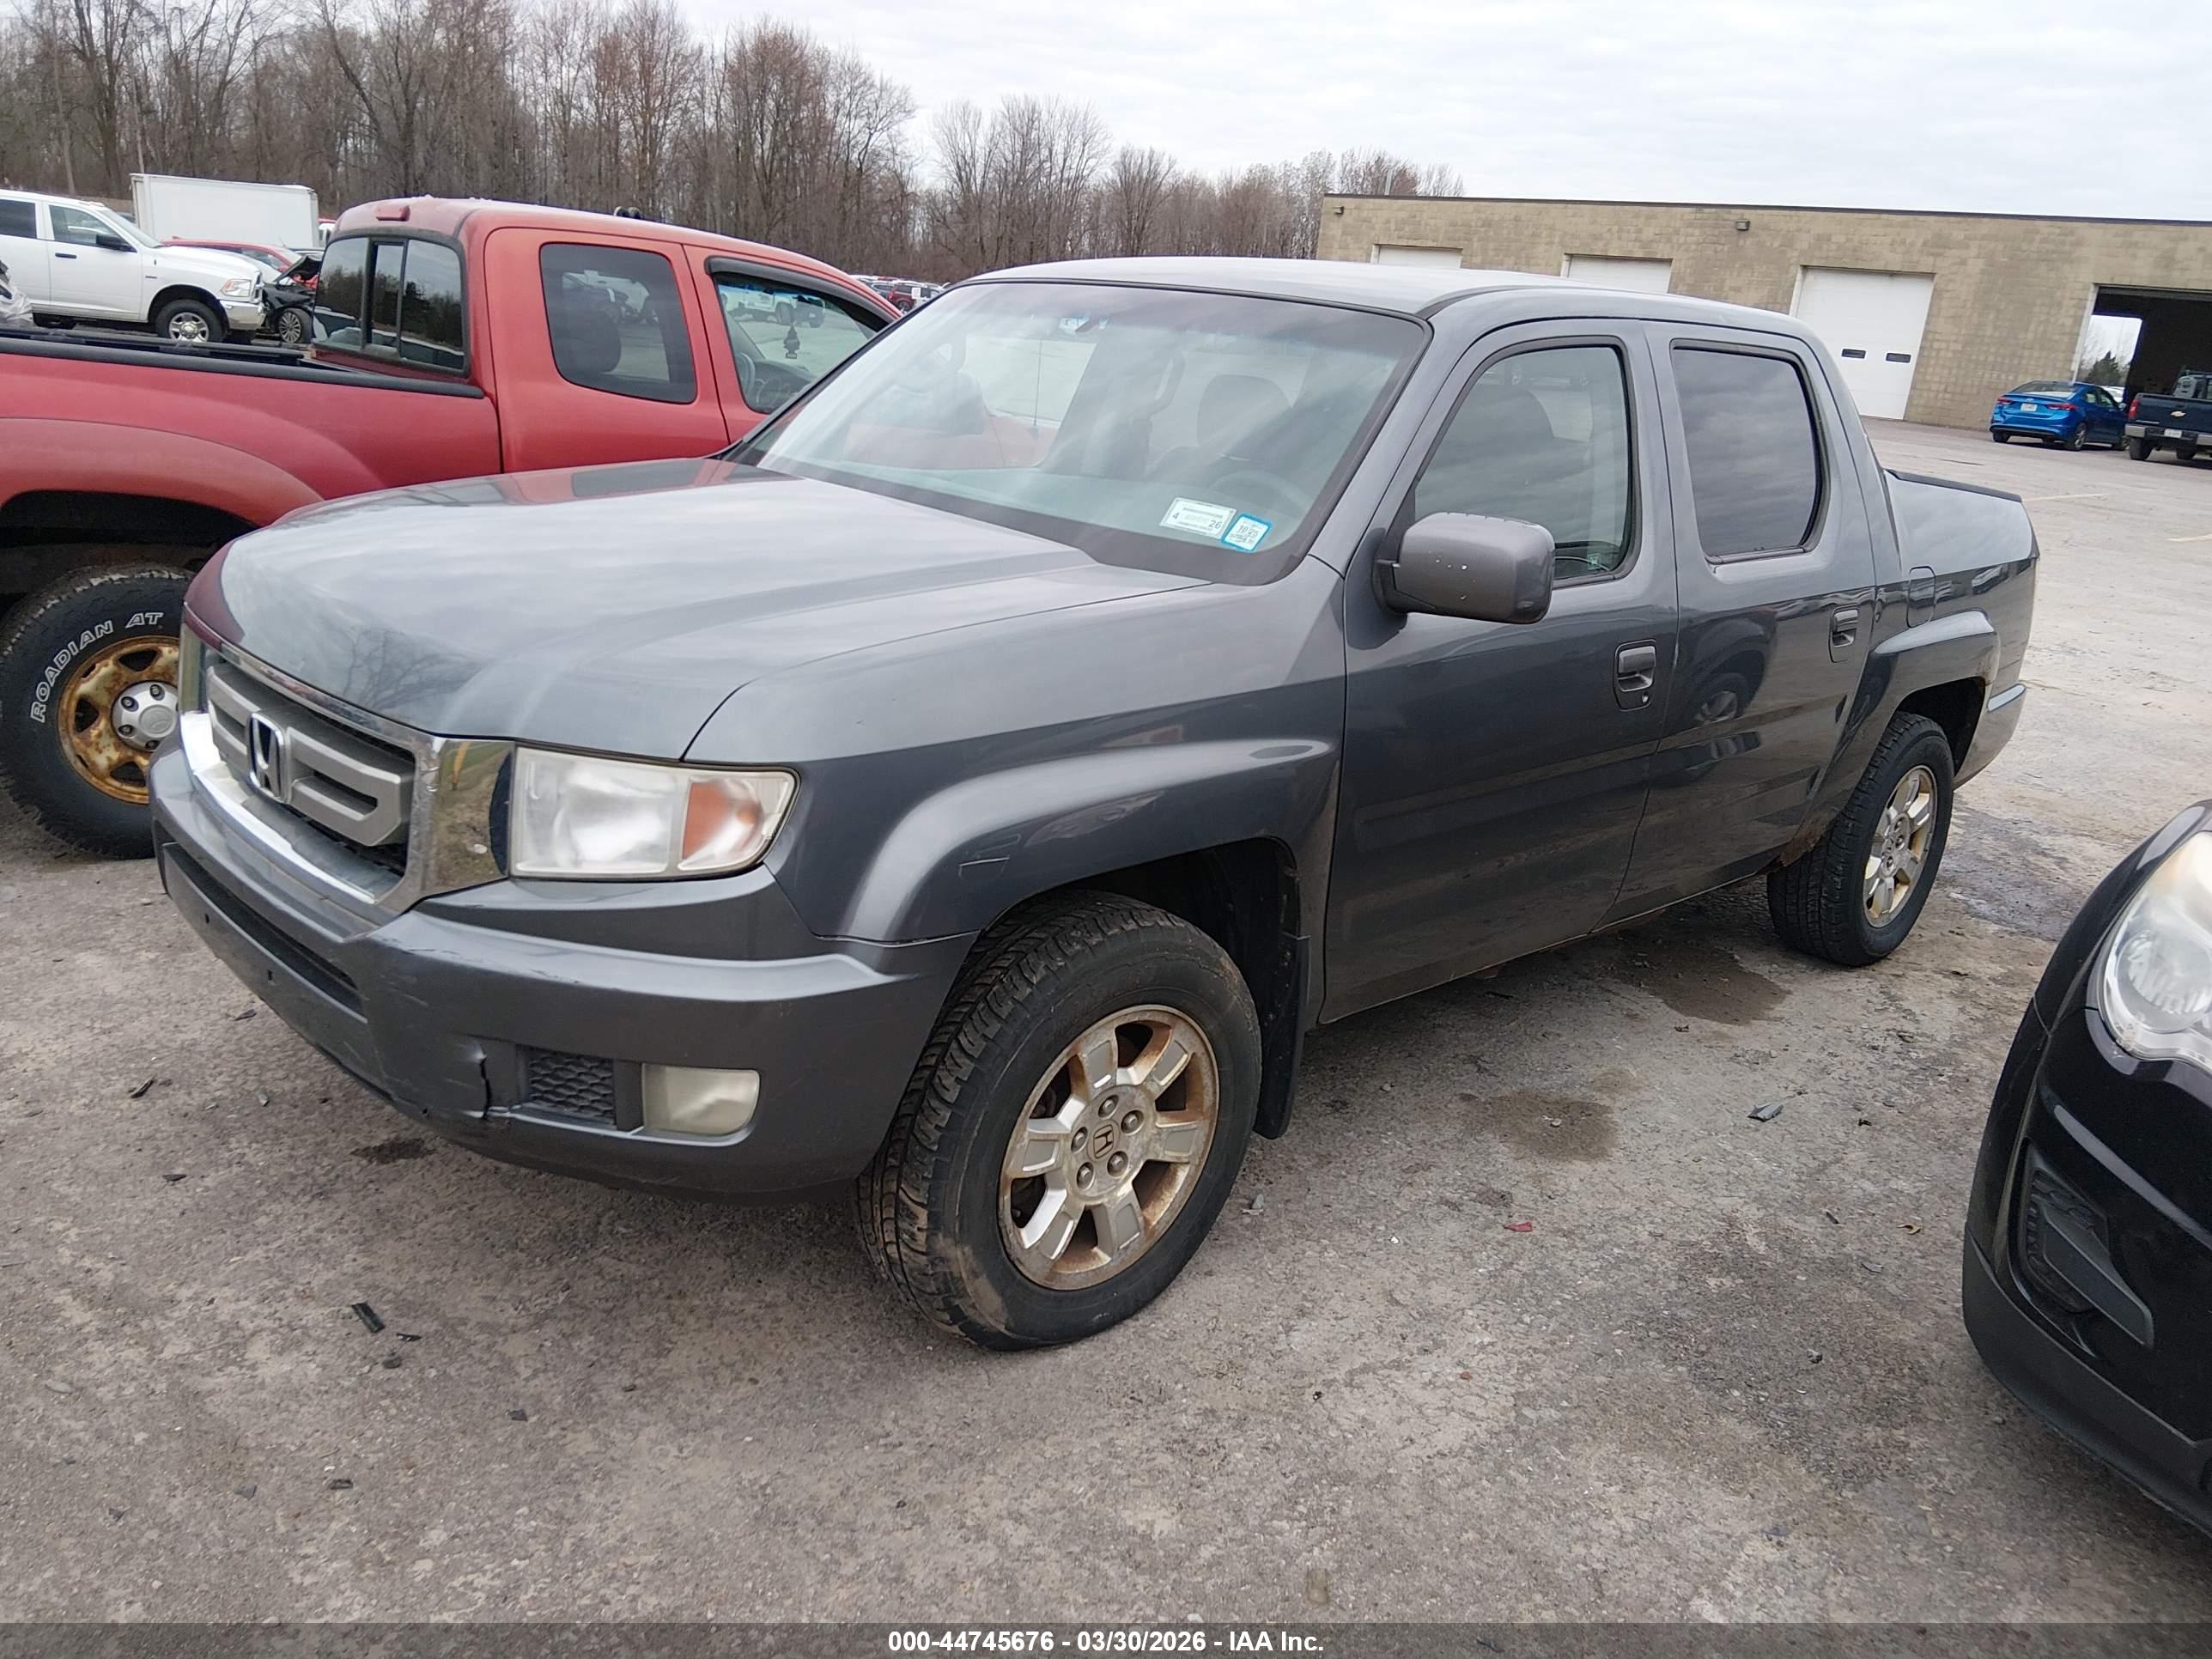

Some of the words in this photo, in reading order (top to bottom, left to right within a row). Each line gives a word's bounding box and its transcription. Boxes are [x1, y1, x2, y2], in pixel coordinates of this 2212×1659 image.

[1209, 520, 1223, 530] 26
[30, 620, 113, 723] ROADIAN
[125, 612, 164, 629] AT
